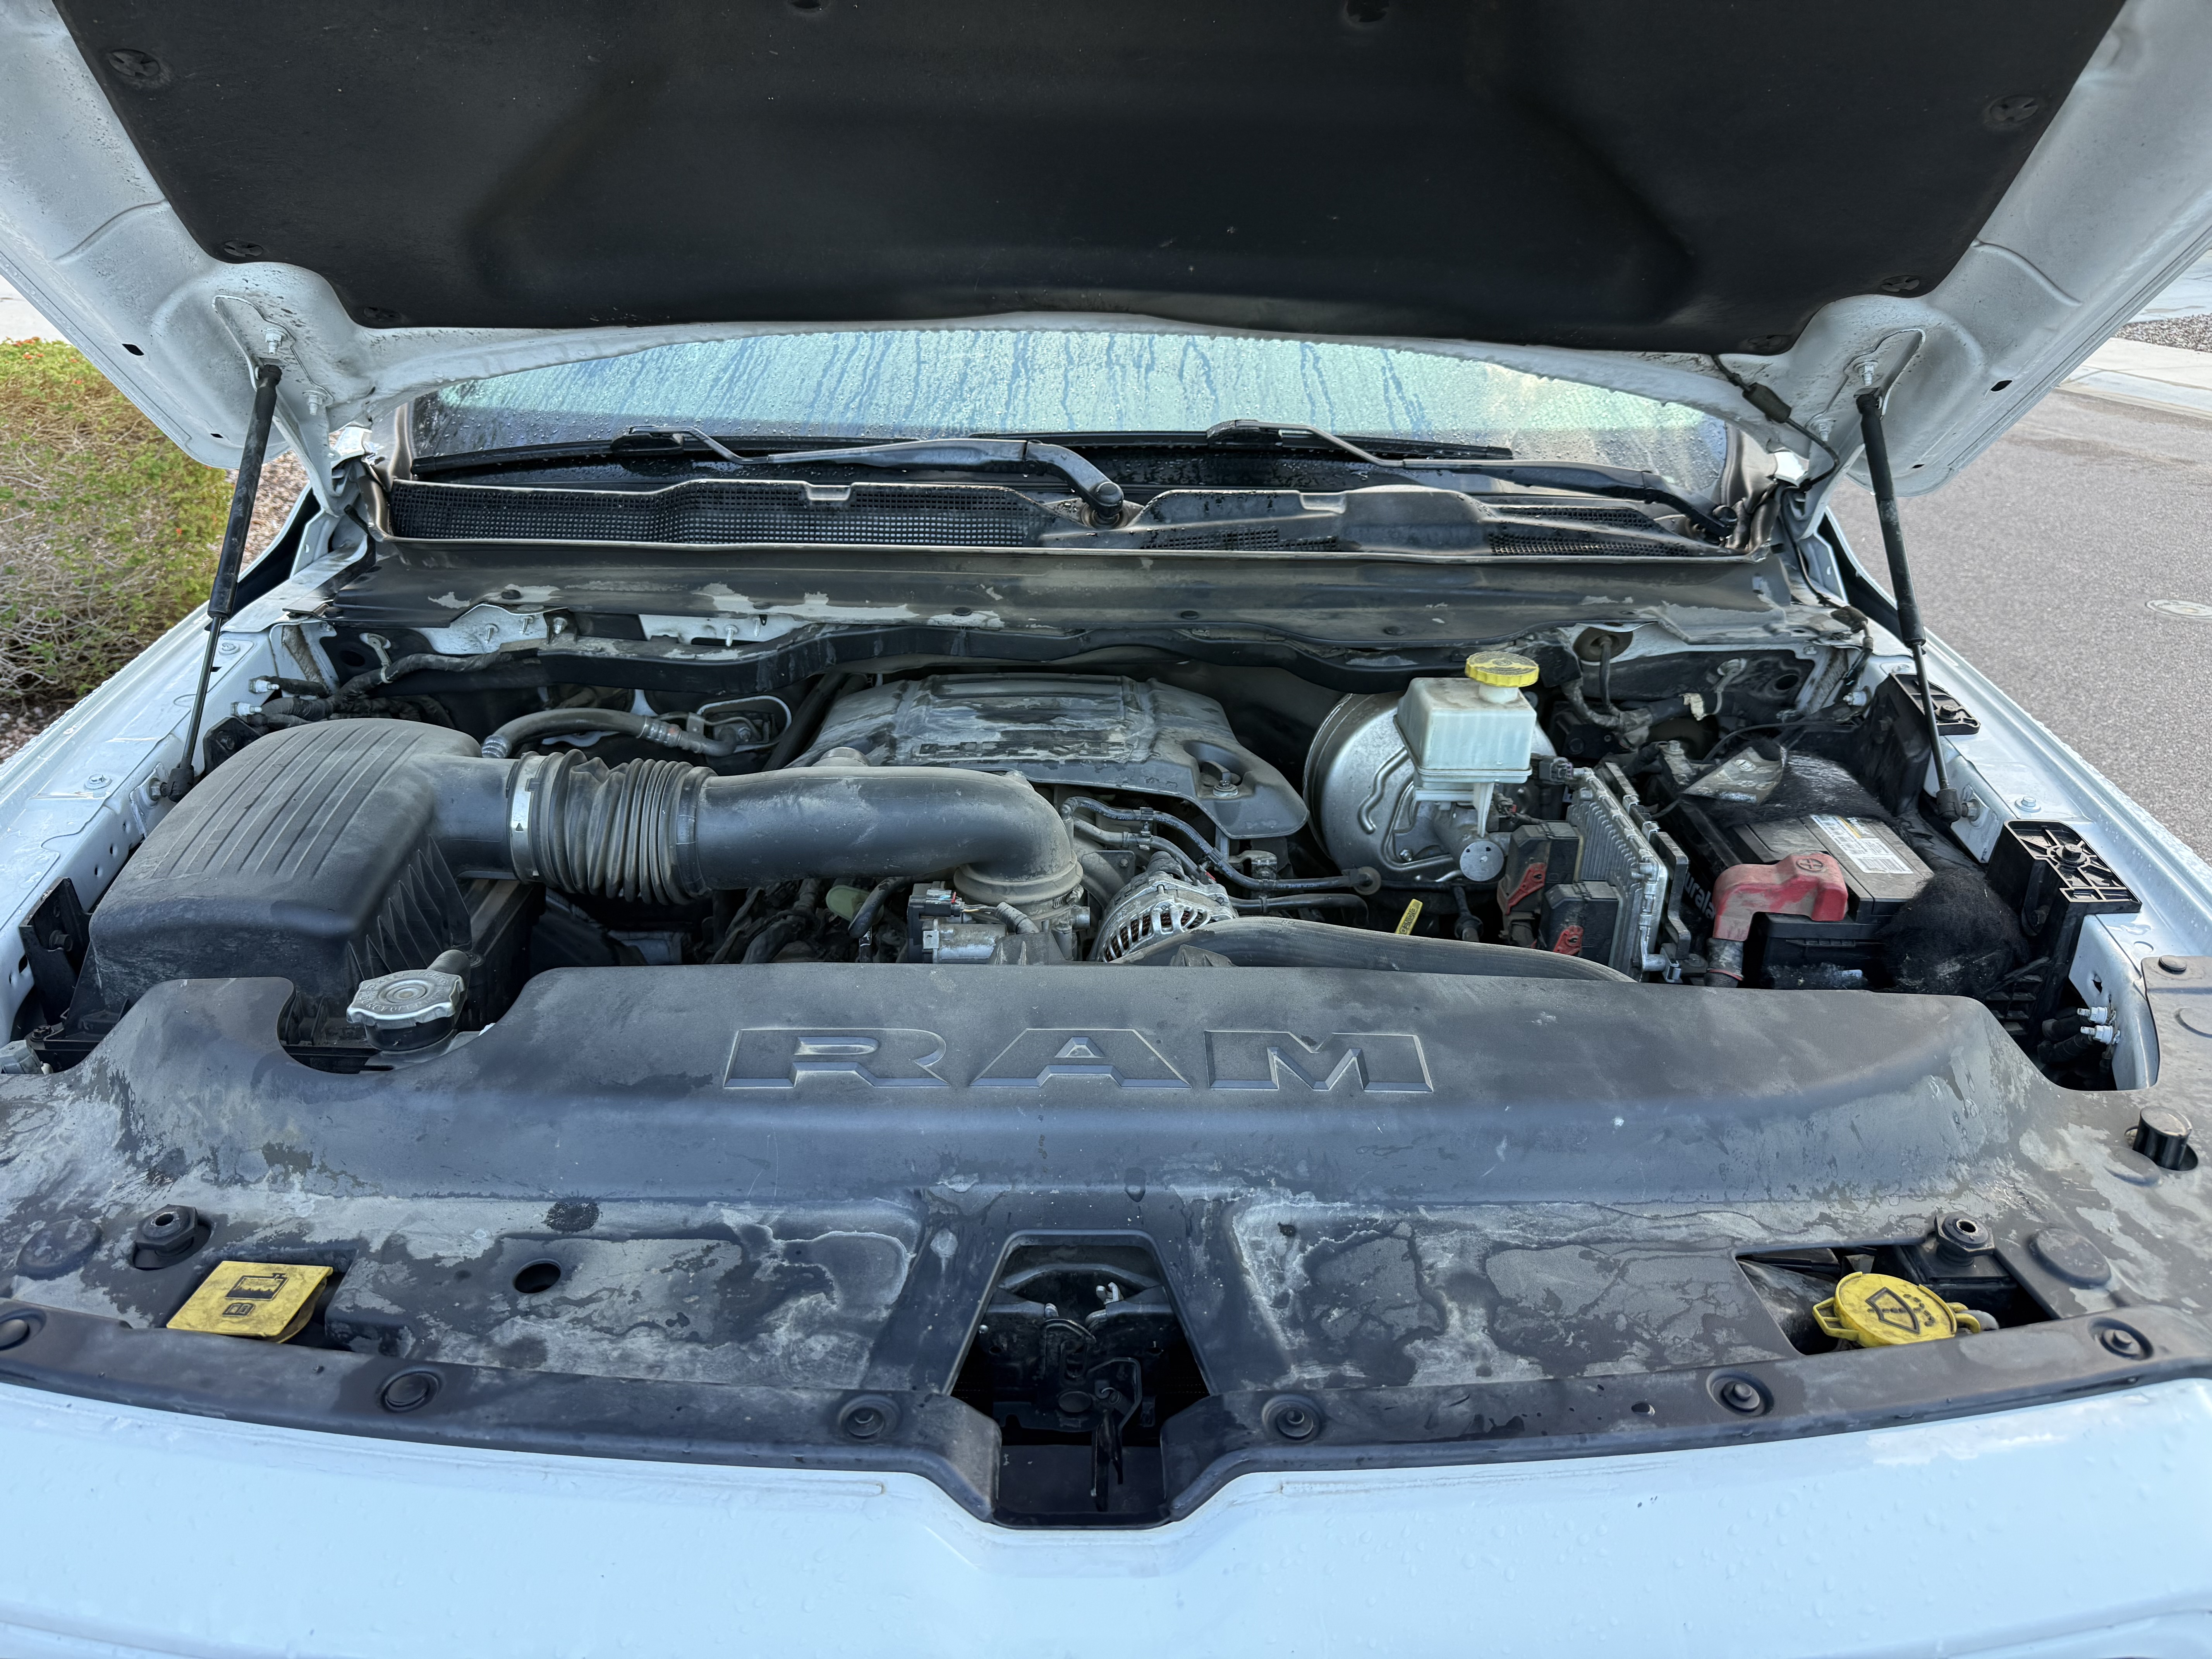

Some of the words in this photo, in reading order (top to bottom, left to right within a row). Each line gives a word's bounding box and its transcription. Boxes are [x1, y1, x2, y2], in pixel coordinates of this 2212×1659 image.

[1403, 907, 1417, 928] ENGINE
[1684, 871, 1716, 920] urala
[724, 1029, 1434, 1092] RAM
